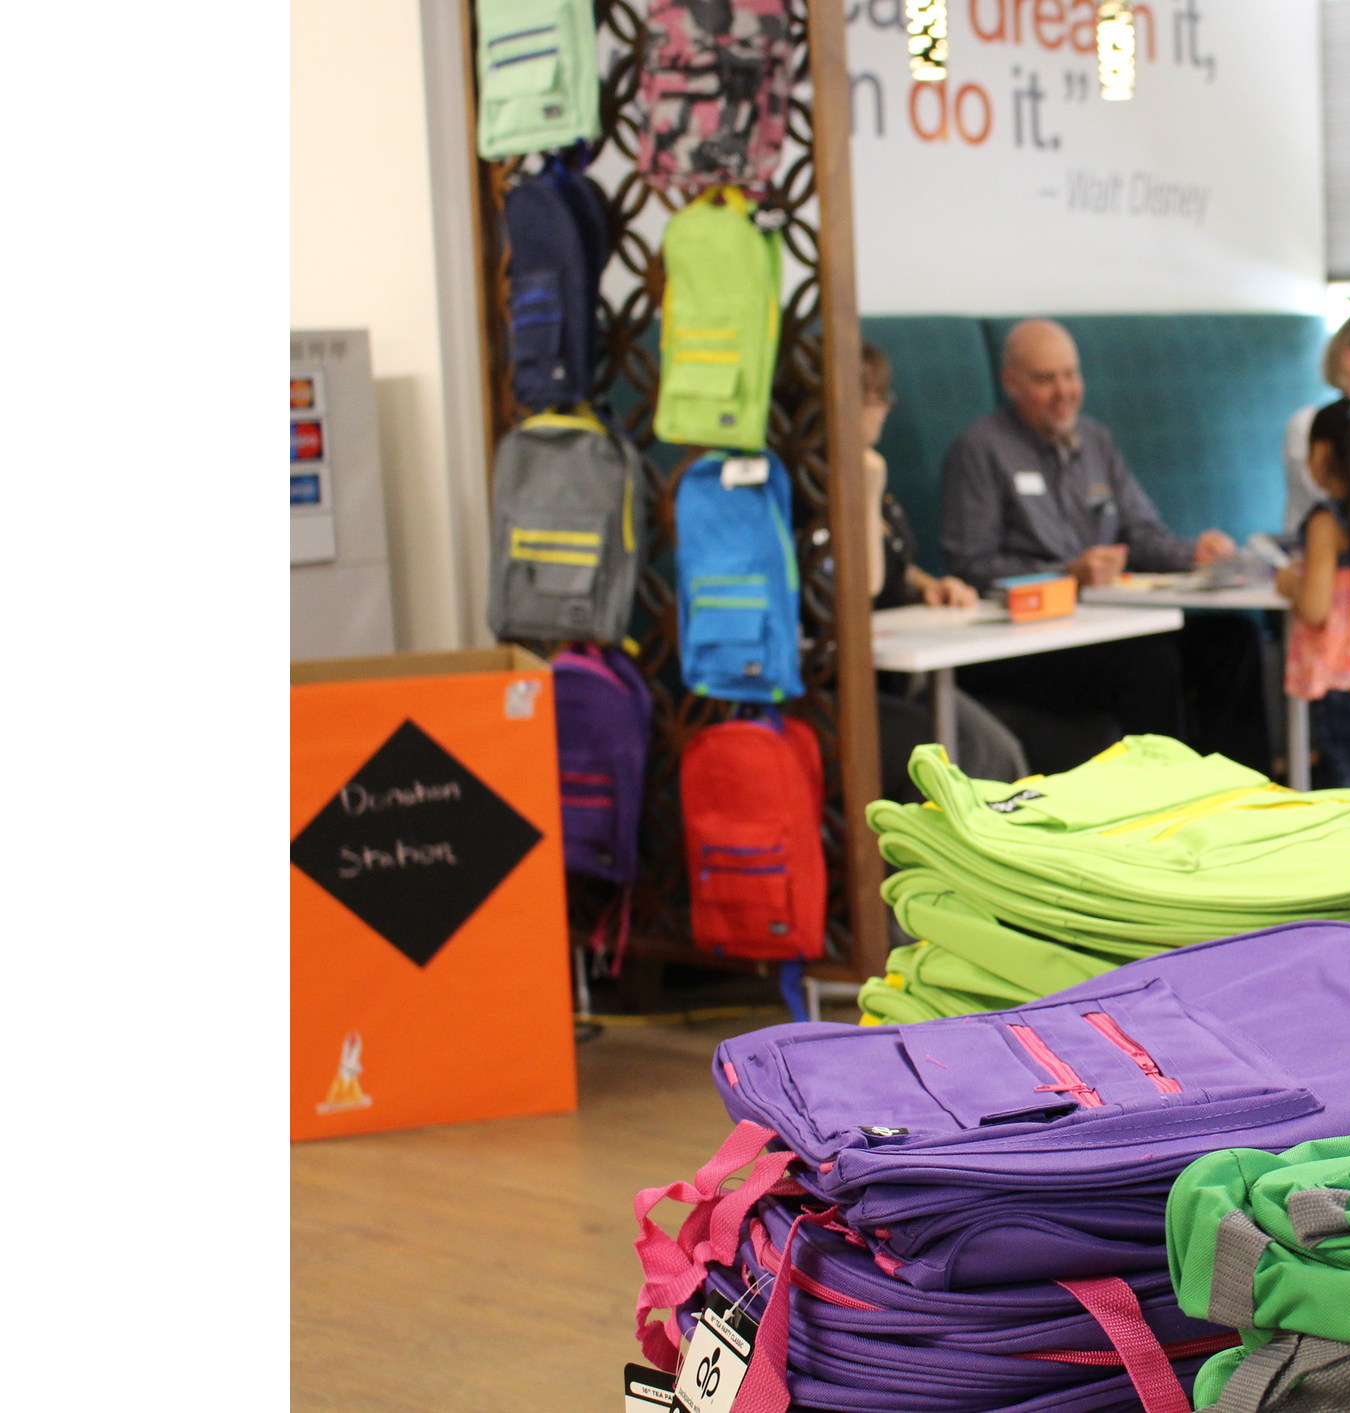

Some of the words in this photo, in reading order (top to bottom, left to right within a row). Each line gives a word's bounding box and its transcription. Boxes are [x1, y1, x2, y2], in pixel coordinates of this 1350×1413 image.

[909, 80, 993, 145] do
[1065, 167, 1123, 215] Walt
[1127, 169, 1210, 227] Disney
[340, 779, 461, 817] Donation
[338, 838, 458, 879] Station
[652, 1390, 663, 1399] TEA
